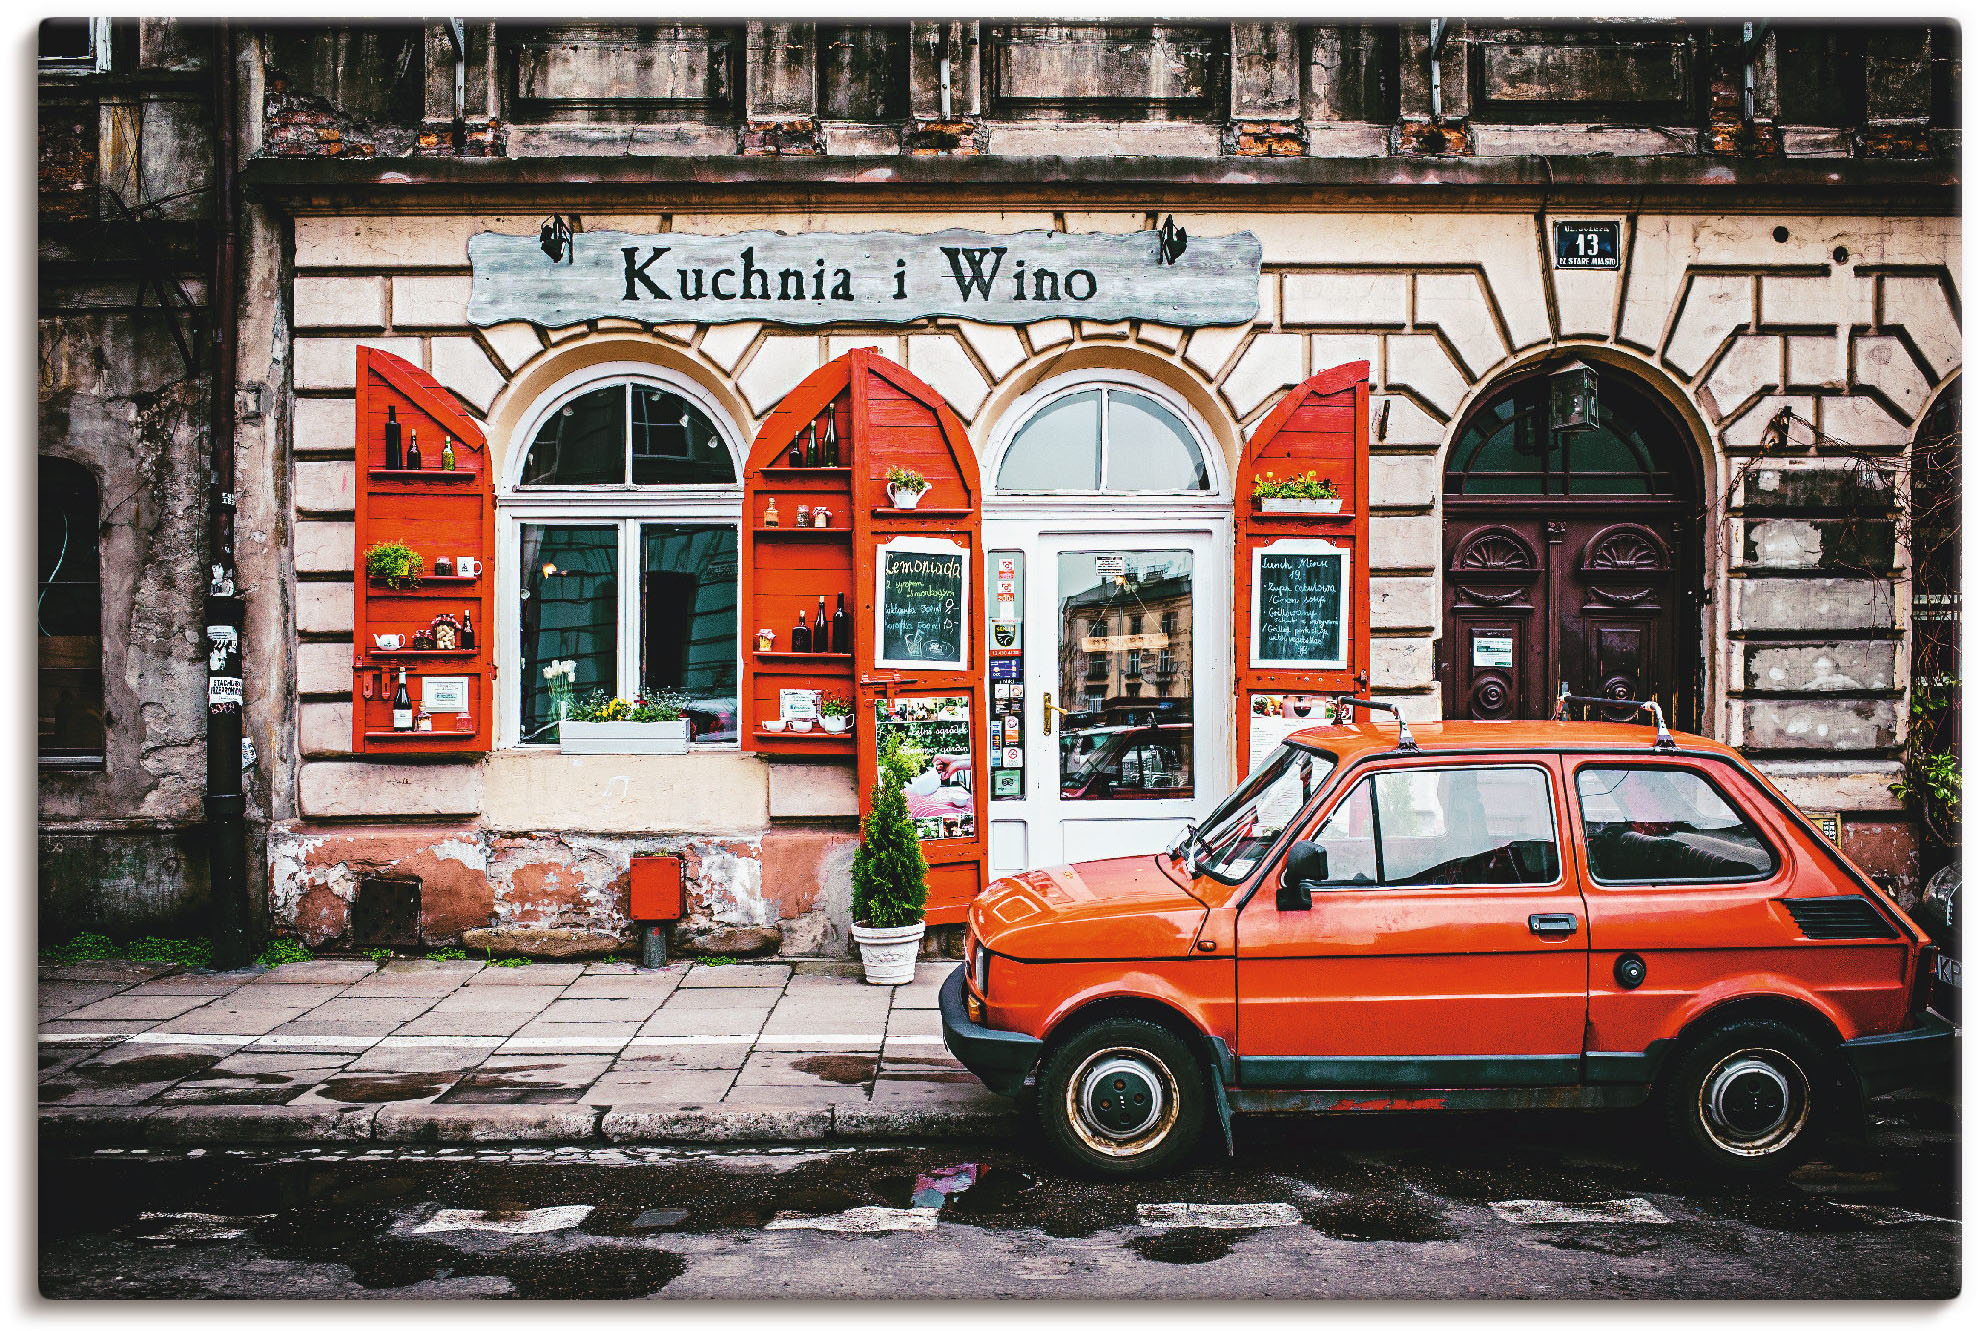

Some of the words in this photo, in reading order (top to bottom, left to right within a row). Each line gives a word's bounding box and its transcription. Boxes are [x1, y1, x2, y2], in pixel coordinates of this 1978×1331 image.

[1575, 233, 1599, 256] 13
[620, 246, 855, 302] Kuchnia
[892, 258, 907, 300] i
[940, 246, 1099, 303] Wino
